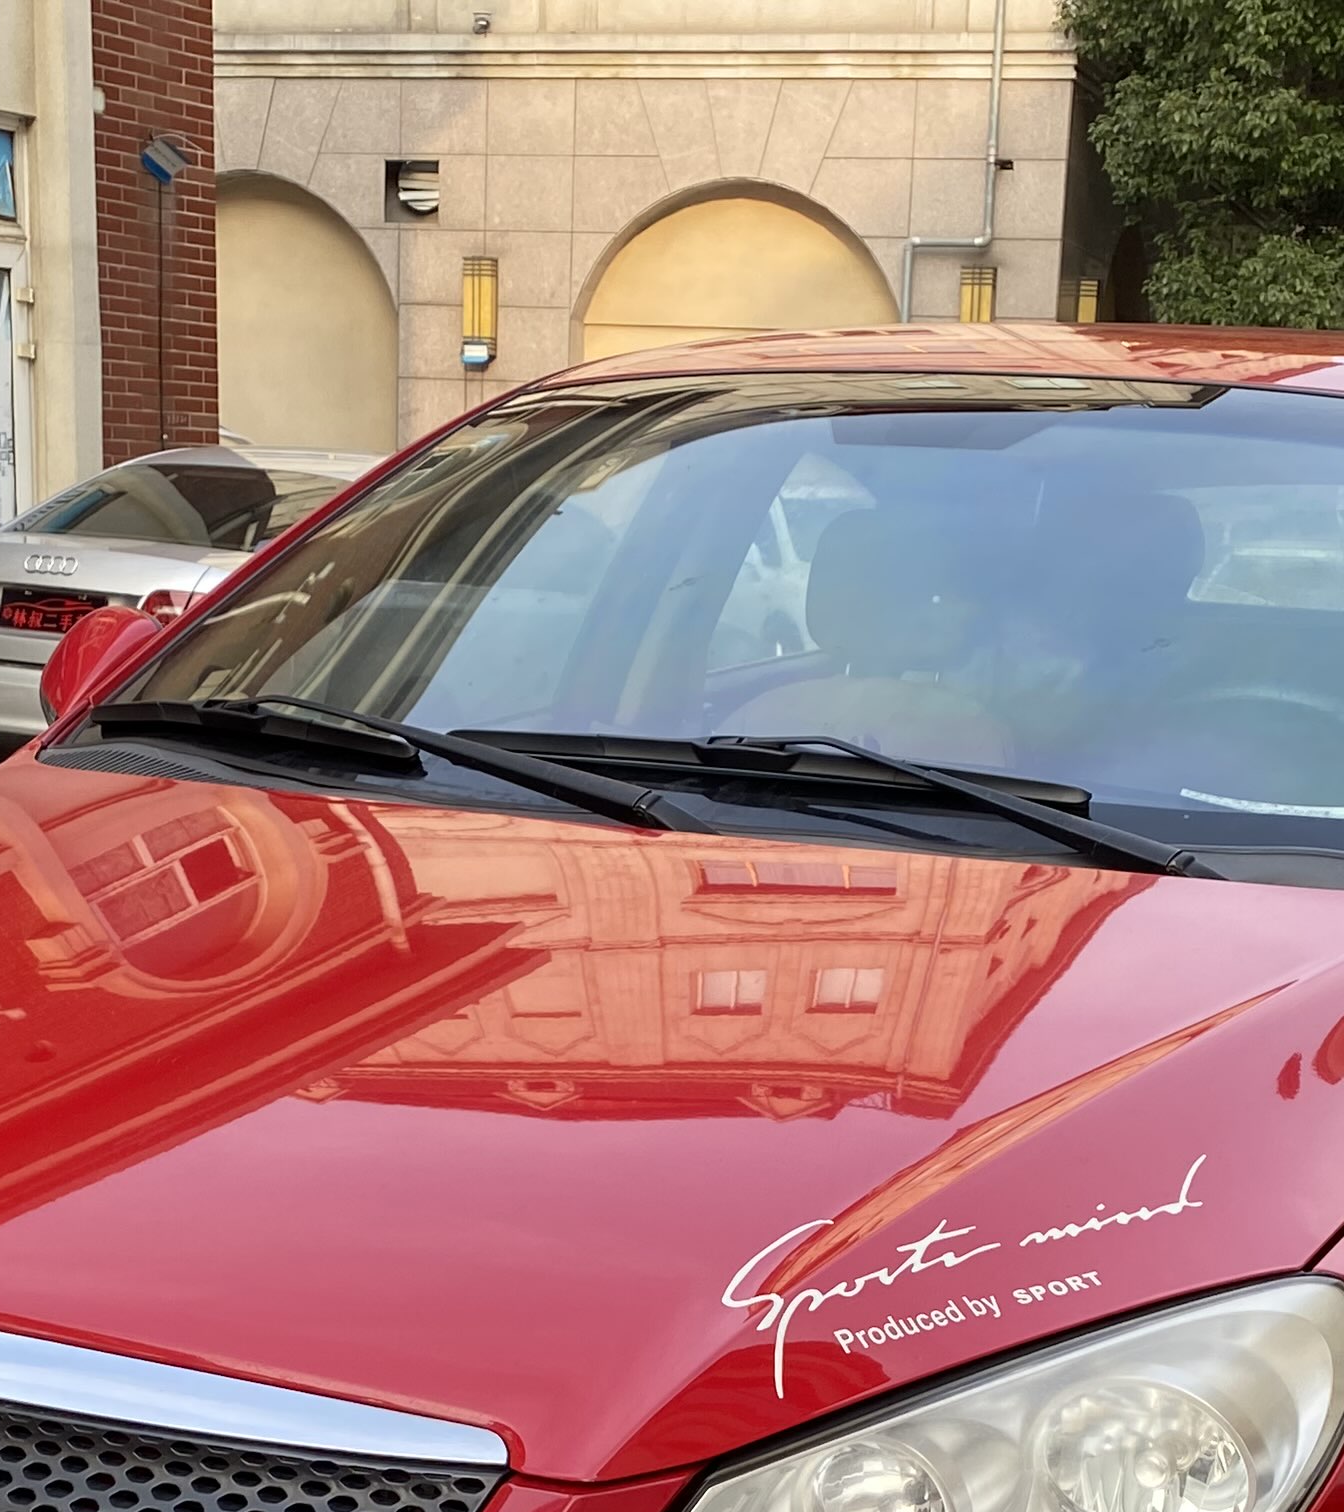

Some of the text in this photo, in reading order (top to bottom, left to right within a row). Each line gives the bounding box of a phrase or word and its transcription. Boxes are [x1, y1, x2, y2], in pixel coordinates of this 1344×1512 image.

[13, 608, 83, 632] 林叔二手
[1019, 1154, 1207, 1247] mind
[833, 1270, 1103, 1355] Produced by SPORT
